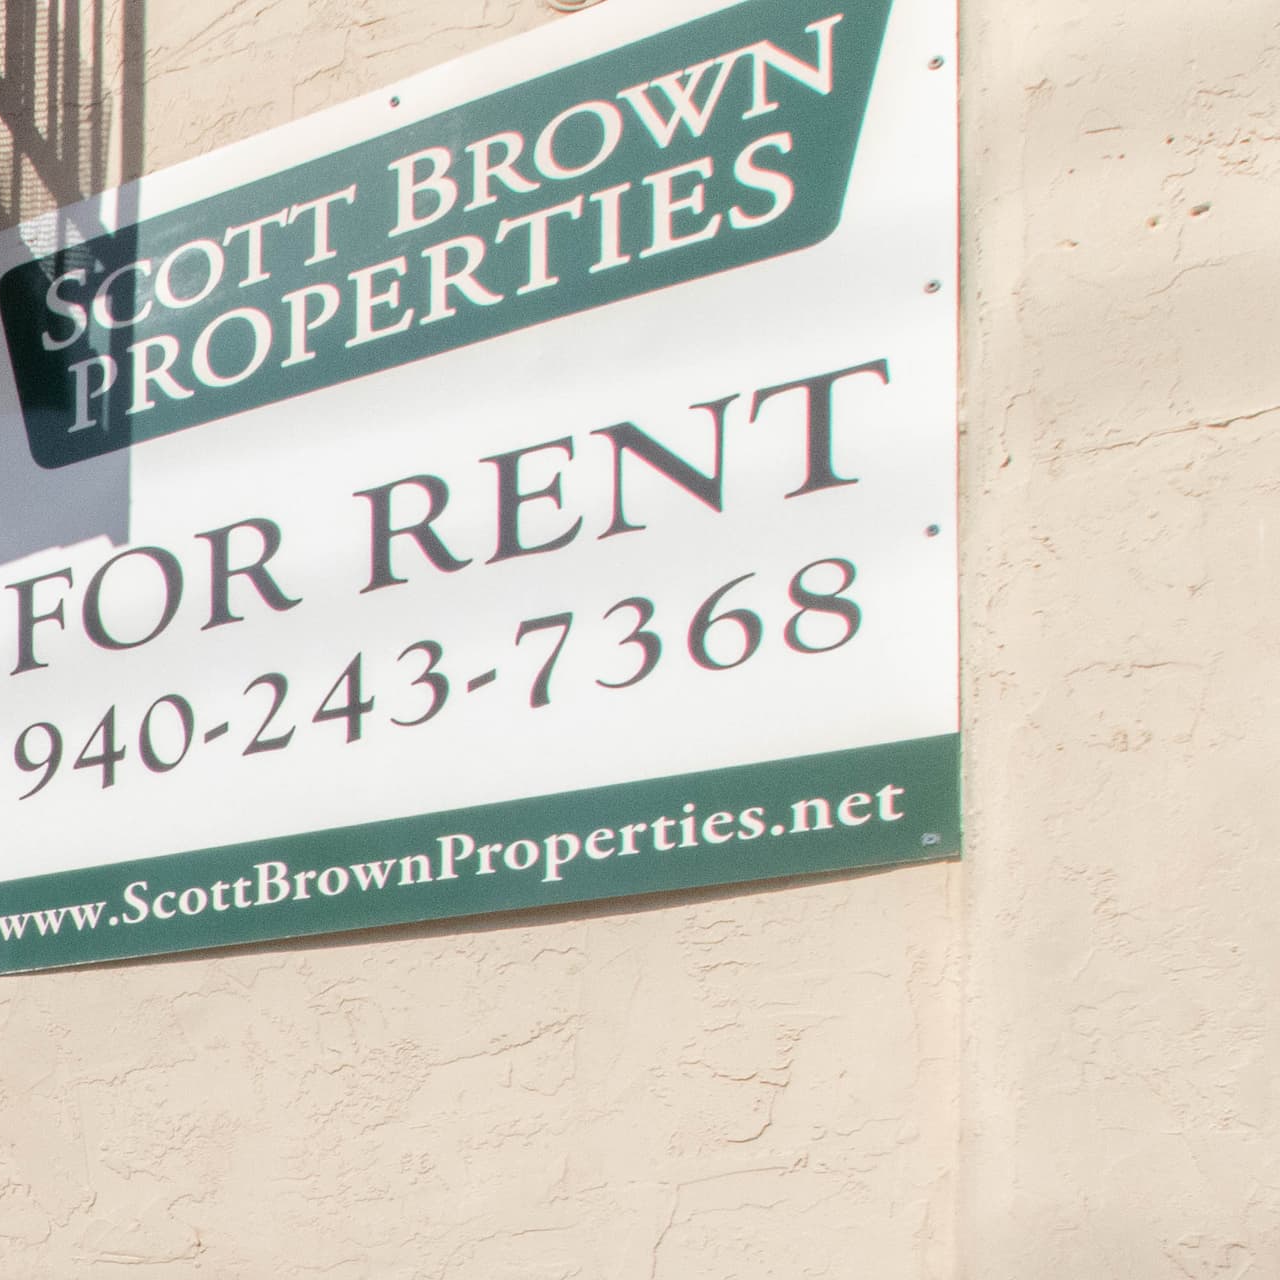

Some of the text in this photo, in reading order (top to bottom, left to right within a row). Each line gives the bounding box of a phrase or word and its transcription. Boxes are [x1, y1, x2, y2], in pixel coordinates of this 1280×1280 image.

[40, 13, 843, 351] SCOTT BROWN
[67, 131, 796, 434] PROPERTIES
[4, 358, 891, 678] FOR RENT
[12, 556, 864, 801] 940-243-7368
